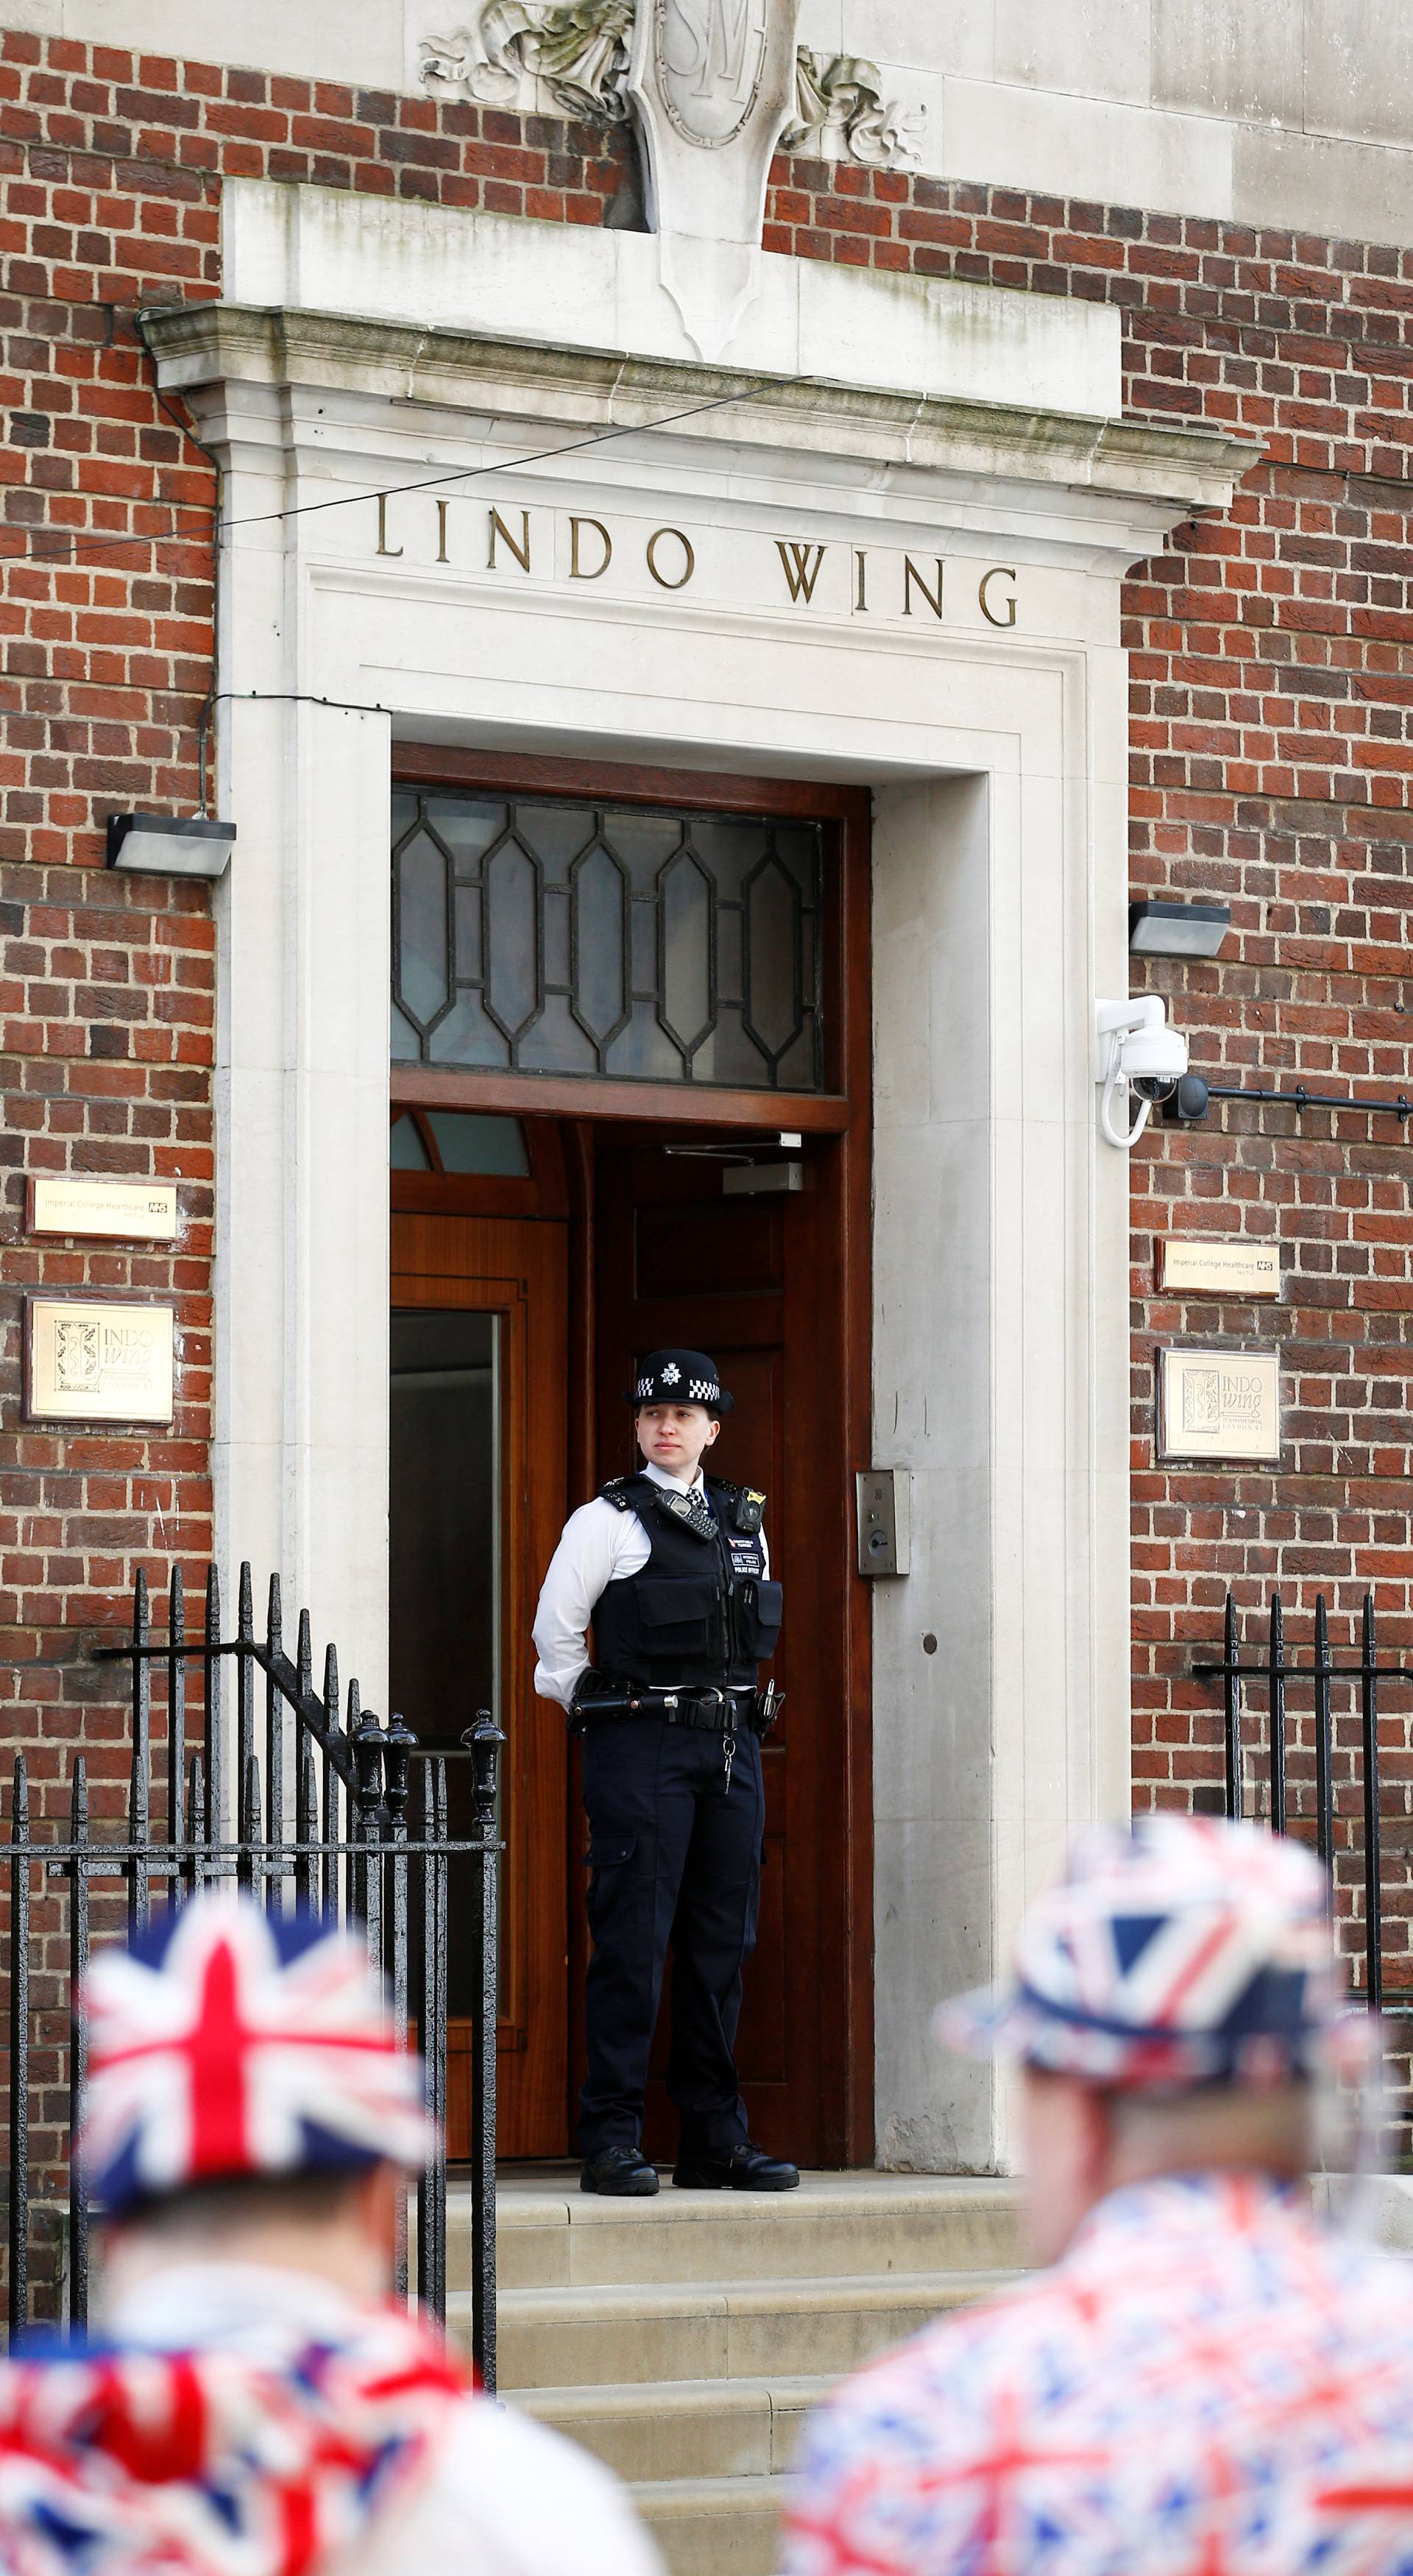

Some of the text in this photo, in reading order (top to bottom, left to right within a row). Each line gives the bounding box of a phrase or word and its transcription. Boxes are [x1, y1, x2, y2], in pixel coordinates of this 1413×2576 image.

[375, 495, 1018, 626] LINDO WING
[45, 1199, 168, 1213] Imperial College Healthcare NHS
[1173, 1259, 1272, 1270] Imperial College Healthcare NHS
[1222, 1393, 1262, 1418] wing
